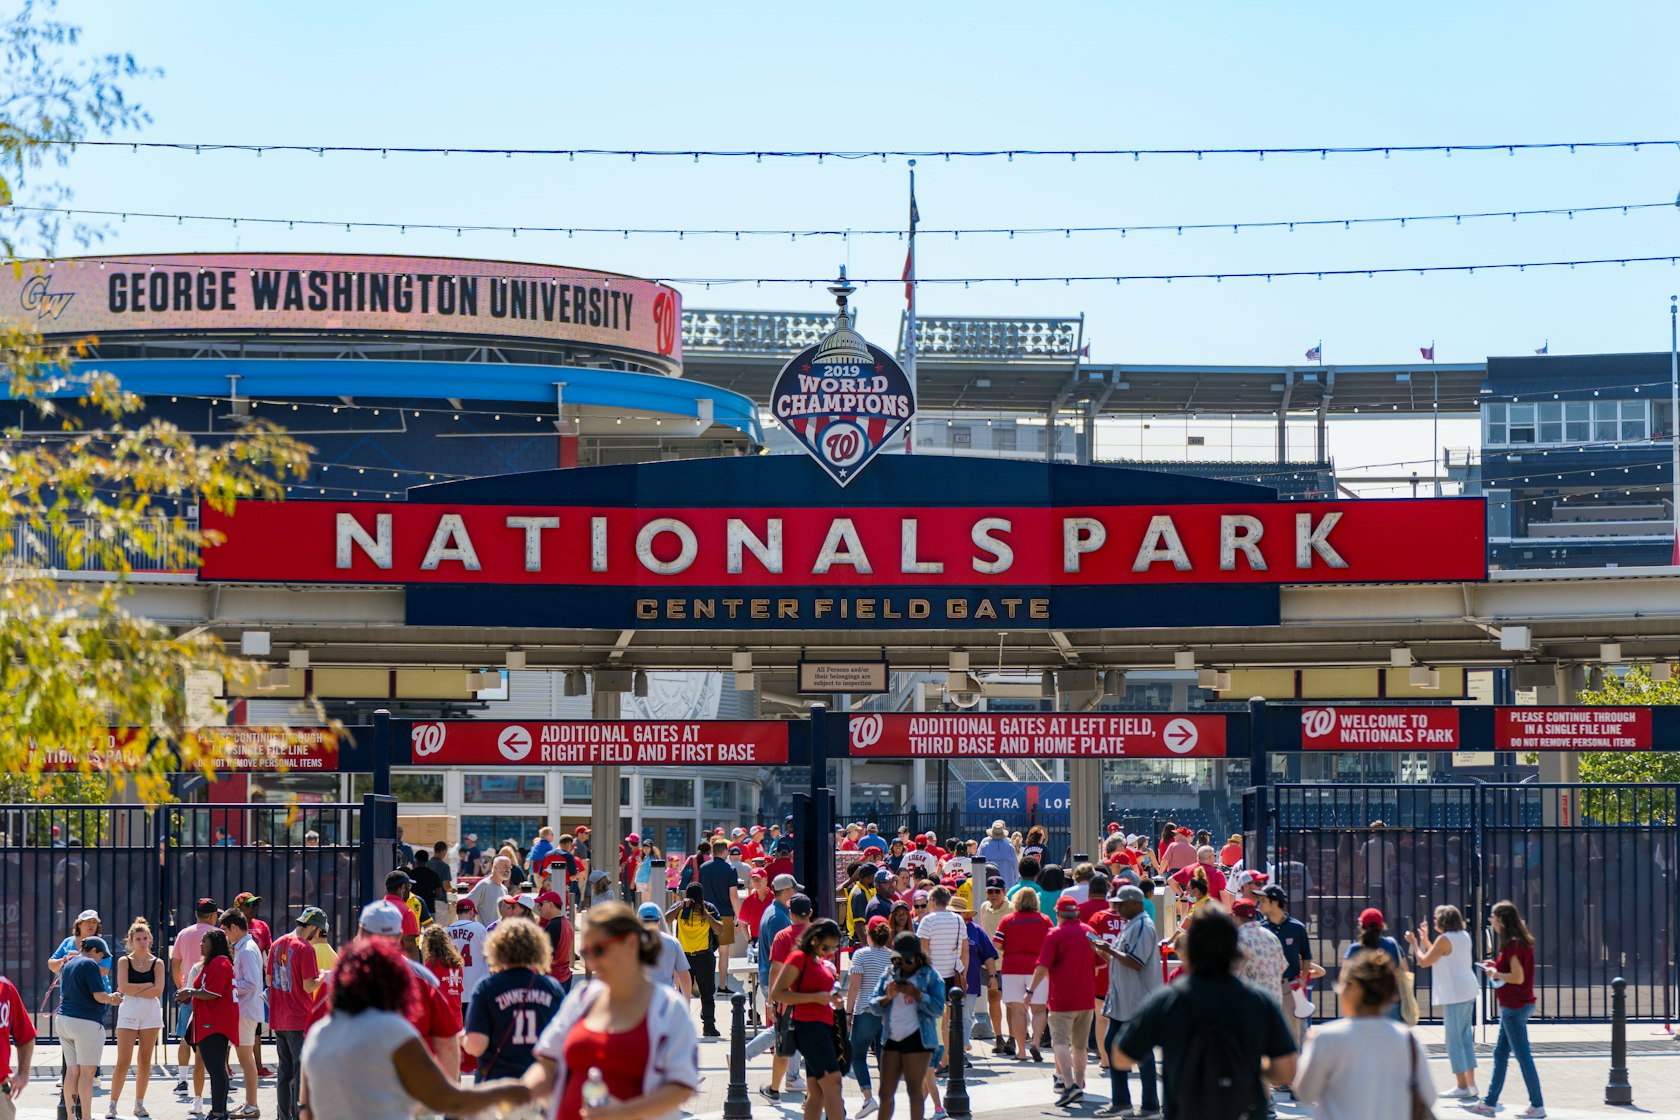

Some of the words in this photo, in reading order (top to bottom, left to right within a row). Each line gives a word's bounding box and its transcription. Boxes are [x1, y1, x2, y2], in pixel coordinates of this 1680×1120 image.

[109, 271, 236, 313] GEORGE
[252, 270, 477, 316] WASHINGTON
[490, 278, 633, 331] UNIVERSITY
[824, 365, 860, 377] 2019
[798, 374, 889, 394] WORLD
[777, 394, 910, 418] CHAMPIONS
[335, 512, 1014, 576] NATIONALS
[1063, 511, 1349, 572] PARK
[637, 598, 800, 620] CENTER
[814, 598, 932, 619] FIELD
[946, 598, 1050, 619] GATE
[1339, 714, 1408, 729] WELCOME
[1410, 714, 1428, 729] TO
[1510, 711, 1545, 722] PLEASE
[1546, 711, 1592, 722] CONTINUE
[1593, 711, 1637, 722] THROUGH
[540, 725, 629, 743] ADDITIONAL
[633, 725, 679, 743] GATES
[683, 725, 701, 743] AT
[909, 718, 996, 735] ADDITIONAL
[1000, 718, 1046, 735] GATES
[1049, 718, 1068, 735] AT
[1071, 718, 1106, 735] LEFT
[1110, 718, 1157, 738] FIELD,
[1340, 729, 1415, 743] NATIONALS
[1417, 729, 1454, 743] PARK
[1524, 724, 1536, 735] IN
[1536, 724, 1544, 735] A
[1545, 724, 1578, 735] SINGLE
[1579, 724, 1600, 735] FILE
[1601, 724, 1623, 735] LINE
[234, 732, 278, 743] CONTINUE
[908, 737, 954, 754] THIRD
[958, 737, 996, 754] BASE
[999, 737, 1030, 754] AND
[1034, 737, 1077, 754] HOME
[1080, 737, 1125, 754] PLATE
[1510, 738, 1523, 747] DO
[1523, 738, 1539, 747] NOT
[1540, 738, 1571, 747] REMOVE
[1572, 738, 1612, 747] PERSONAL
[1612, 738, 1637, 747] ITEMS
[288, 744, 309, 755] LINE
[541, 744, 587, 762] RIGHT
[590, 744, 633, 762] FIELD
[637, 744, 667, 761] AND
[671, 744, 714, 761] FIRST
[718, 743, 756, 761] BASE
[259, 759, 298, 768] PERSONAL
[300, 758, 323, 768] ITEMS
[978, 798, 1020, 809] ULTRA
[495, 988, 553, 1011] ZIMMERMAN
[512, 1009, 539, 1045] 11
